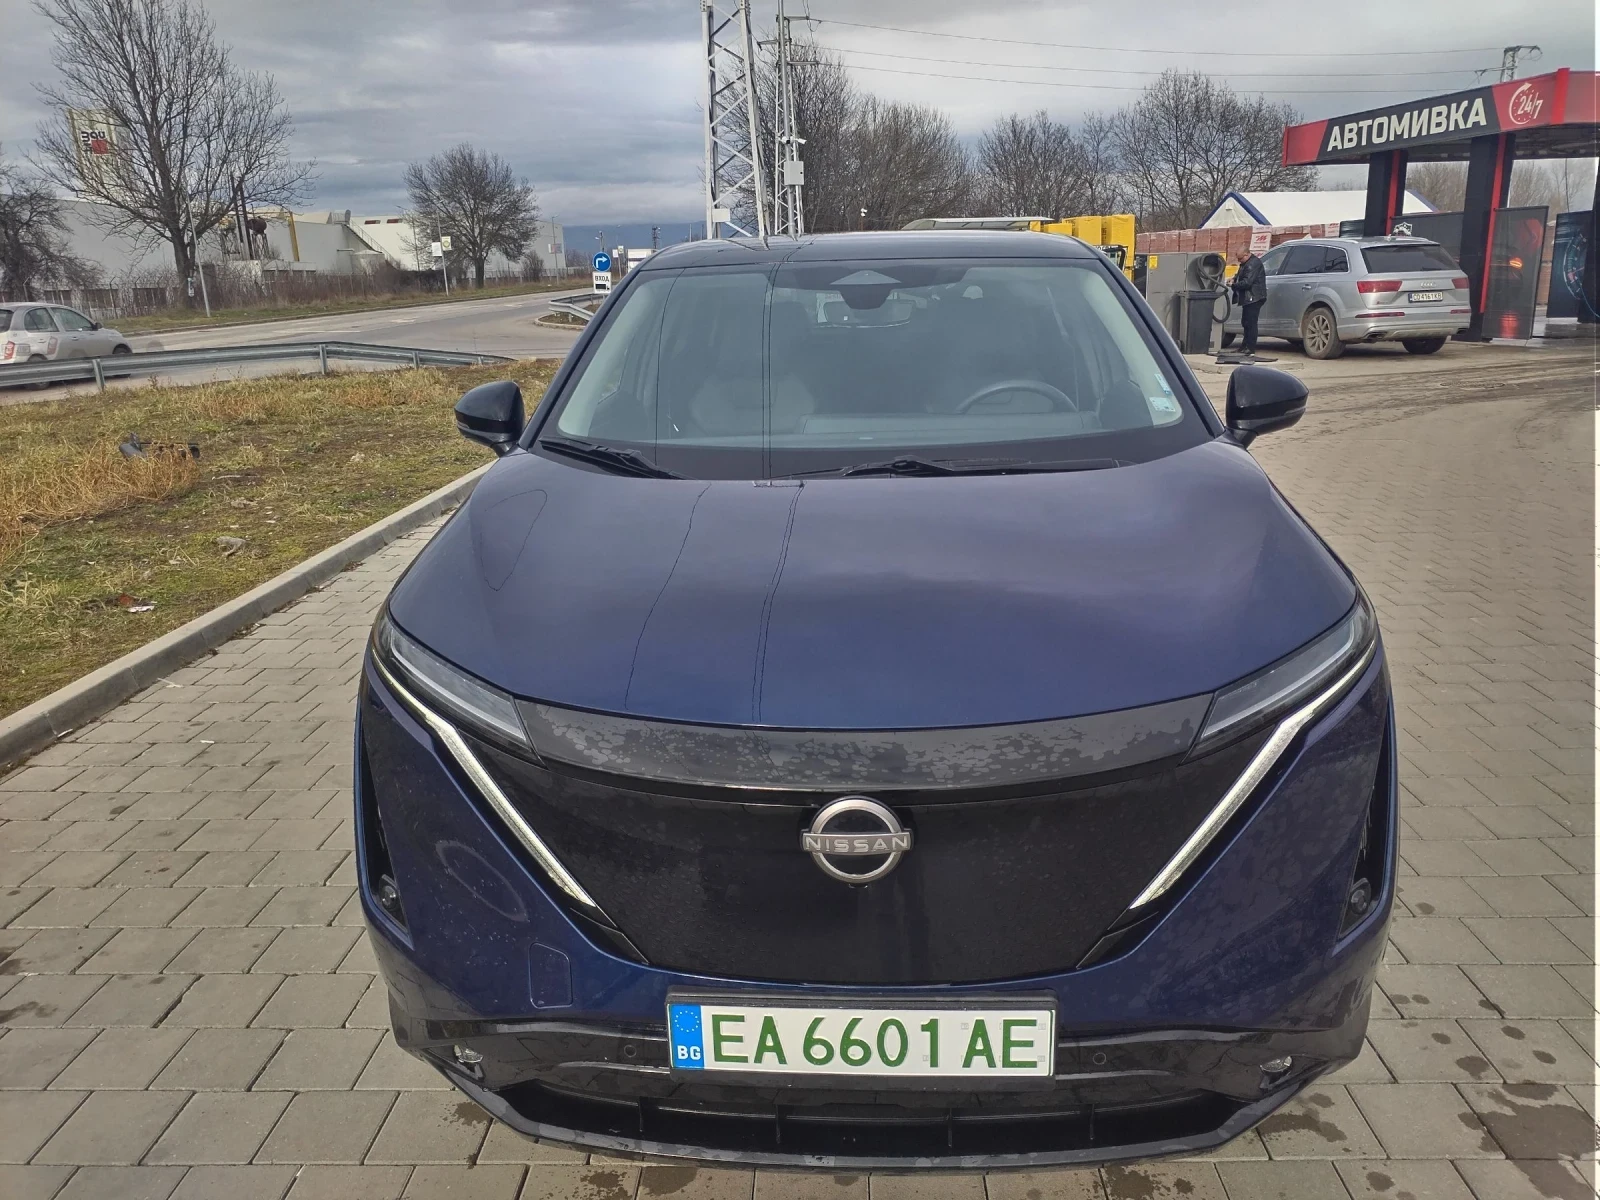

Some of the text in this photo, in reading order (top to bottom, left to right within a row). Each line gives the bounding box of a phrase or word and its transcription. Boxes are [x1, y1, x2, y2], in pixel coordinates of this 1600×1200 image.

[1326, 97, 1487, 152] АВТОМИВКА
[1517, 92, 1544, 119] 24/7
[805, 835, 908, 853] NISSAN
[677, 1014, 1039, 1069] BG EA 6601 AE
